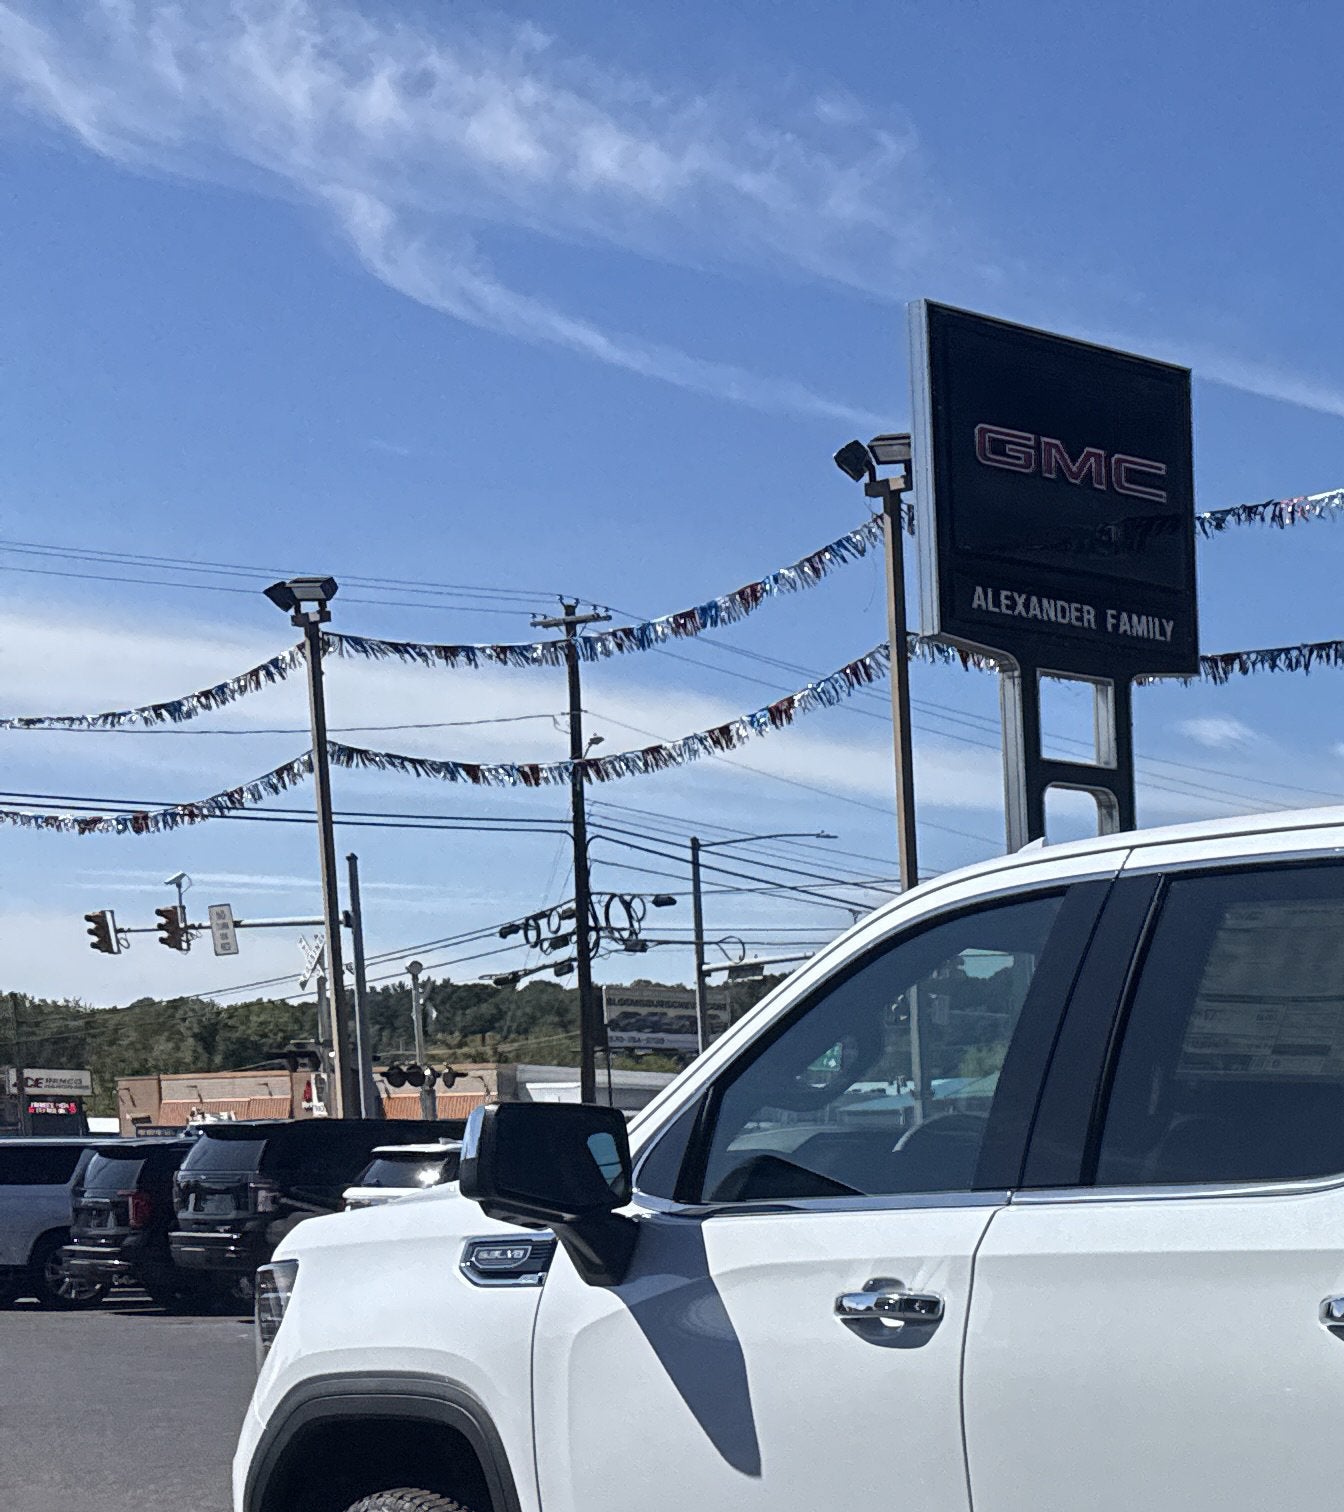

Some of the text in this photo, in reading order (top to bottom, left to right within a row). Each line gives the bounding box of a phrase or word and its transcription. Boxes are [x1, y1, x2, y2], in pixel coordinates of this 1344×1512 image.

[974, 423, 1166, 503] GMC
[972, 585, 1174, 642] ALEXANDER FAMILY
